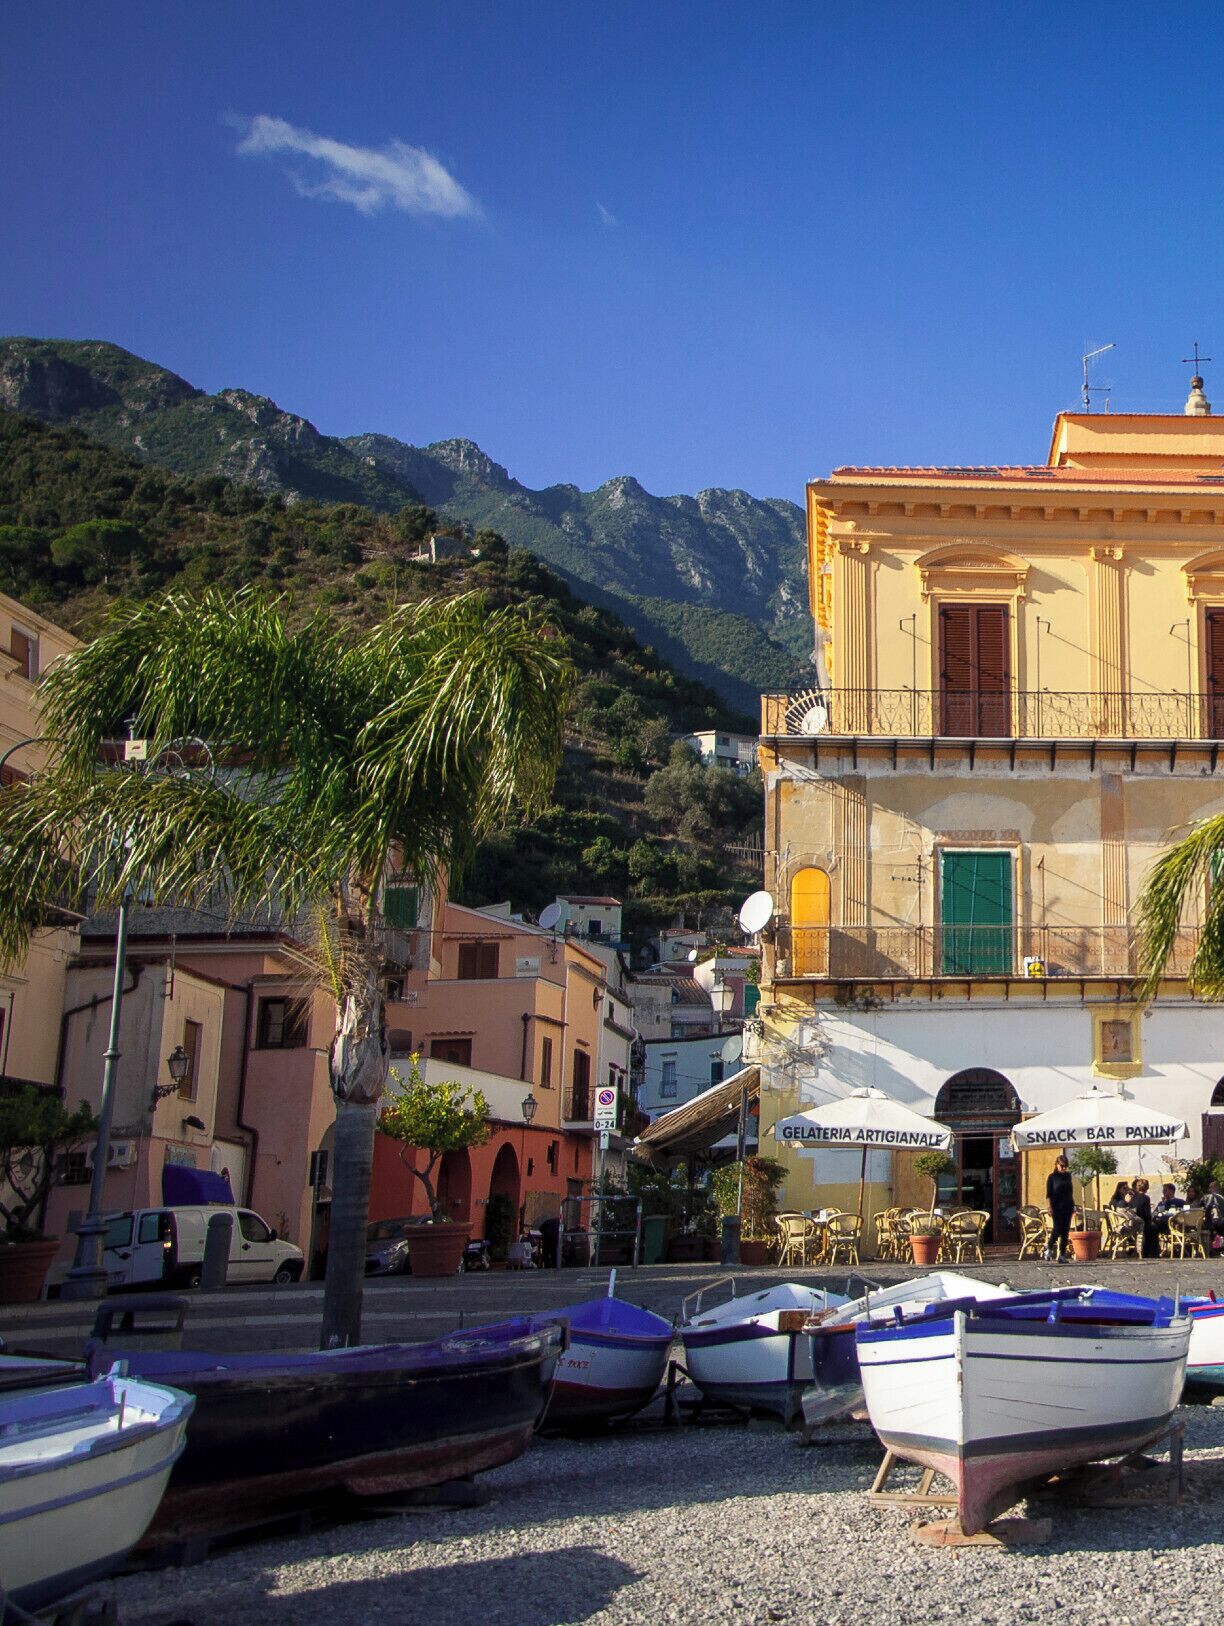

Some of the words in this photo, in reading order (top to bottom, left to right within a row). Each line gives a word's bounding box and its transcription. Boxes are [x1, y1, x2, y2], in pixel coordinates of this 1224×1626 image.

[595, 1121, 614, 1129] 0-24
[1027, 1128, 1077, 1144] SNACK
[1087, 1126, 1115, 1140] BAR
[1125, 1125, 1175, 1139] PANINI
[782, 1126, 852, 1141] GELATERIA
[856, 1128, 943, 1147] ARTIGIANALE
